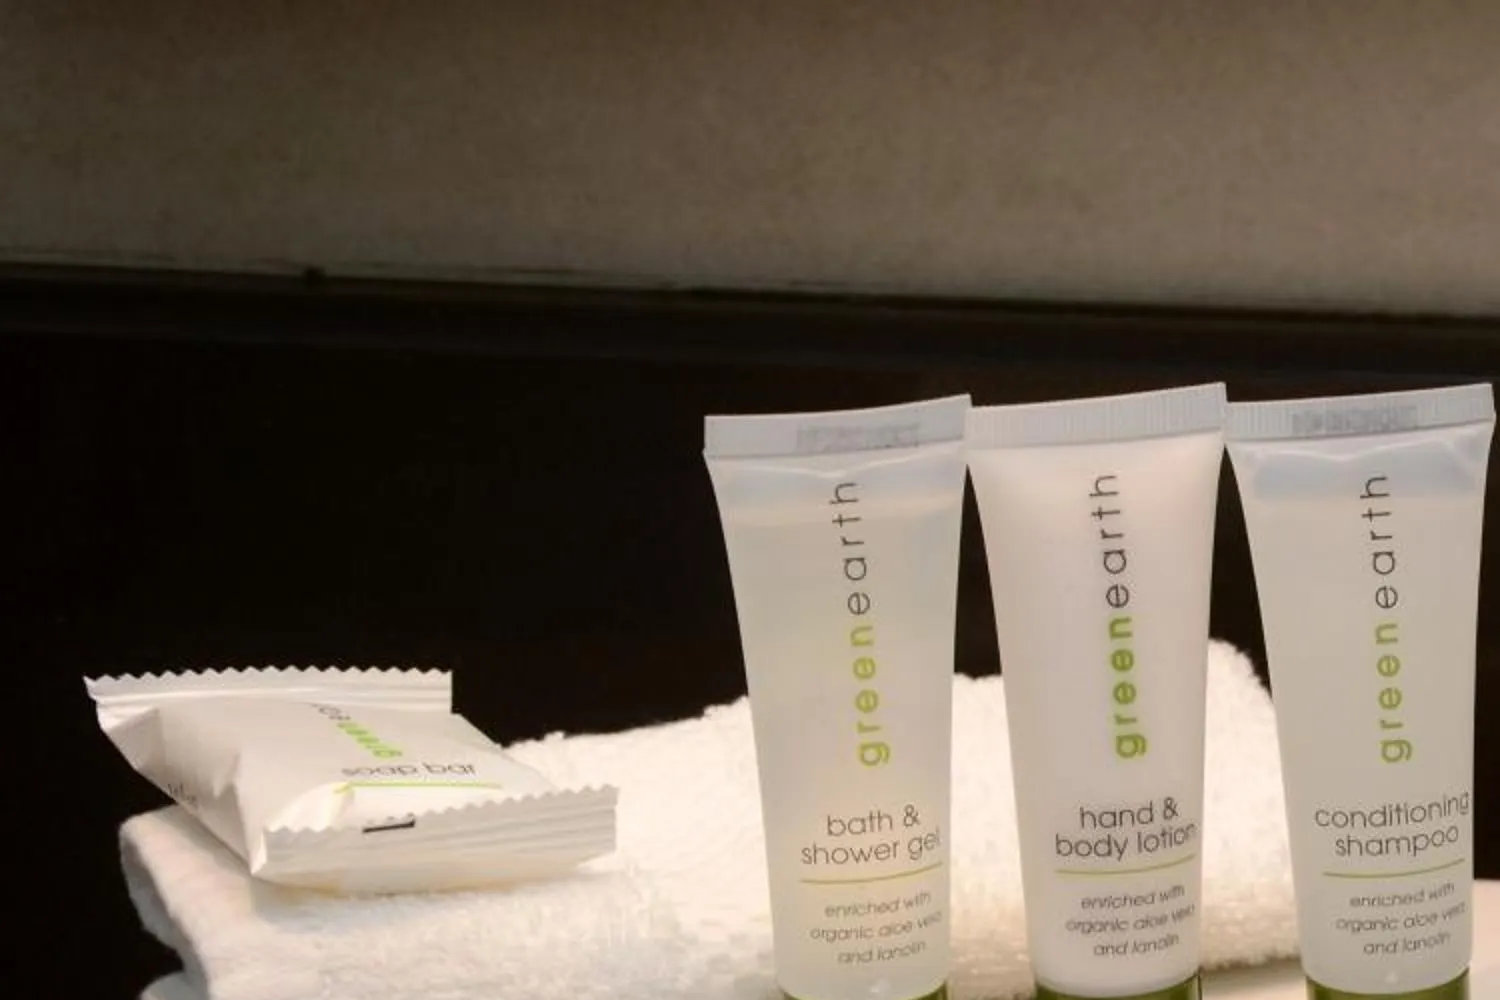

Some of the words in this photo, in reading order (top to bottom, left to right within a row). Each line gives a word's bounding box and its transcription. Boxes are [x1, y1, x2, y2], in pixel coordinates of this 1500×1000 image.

[829, 480, 890, 768] greenearth
[1089, 474, 1148, 759] greenearth
[1359, 474, 1413, 764] greenearth
[341, 764, 419, 776] soap
[421, 761, 476, 775] bar
[826, 810, 893, 837] bath
[902, 804, 921, 828] &
[1079, 800, 1154, 829] hand
[1162, 796, 1179, 820] &
[1314, 792, 1470, 829] conditioning
[800, 841, 900, 865] shower
[907, 826, 941, 860] gel
[1055, 833, 1129, 861] body
[1137, 823, 1197, 853] lotion
[1335, 825, 1459, 857] shampoo
[824, 897, 899, 918] enriched
[902, 891, 932, 909] with
[1080, 892, 1156, 910] enriched
[1350, 889, 1425, 908] enriched
[1429, 881, 1455, 901] with
[810, 926, 874, 943] organic
[1065, 917, 1129, 935] organic
[1335, 916, 1399, 933] organic
[837, 947, 873, 965] and
[1093, 941, 1129, 956] and
[1363, 938, 1399, 955] and
